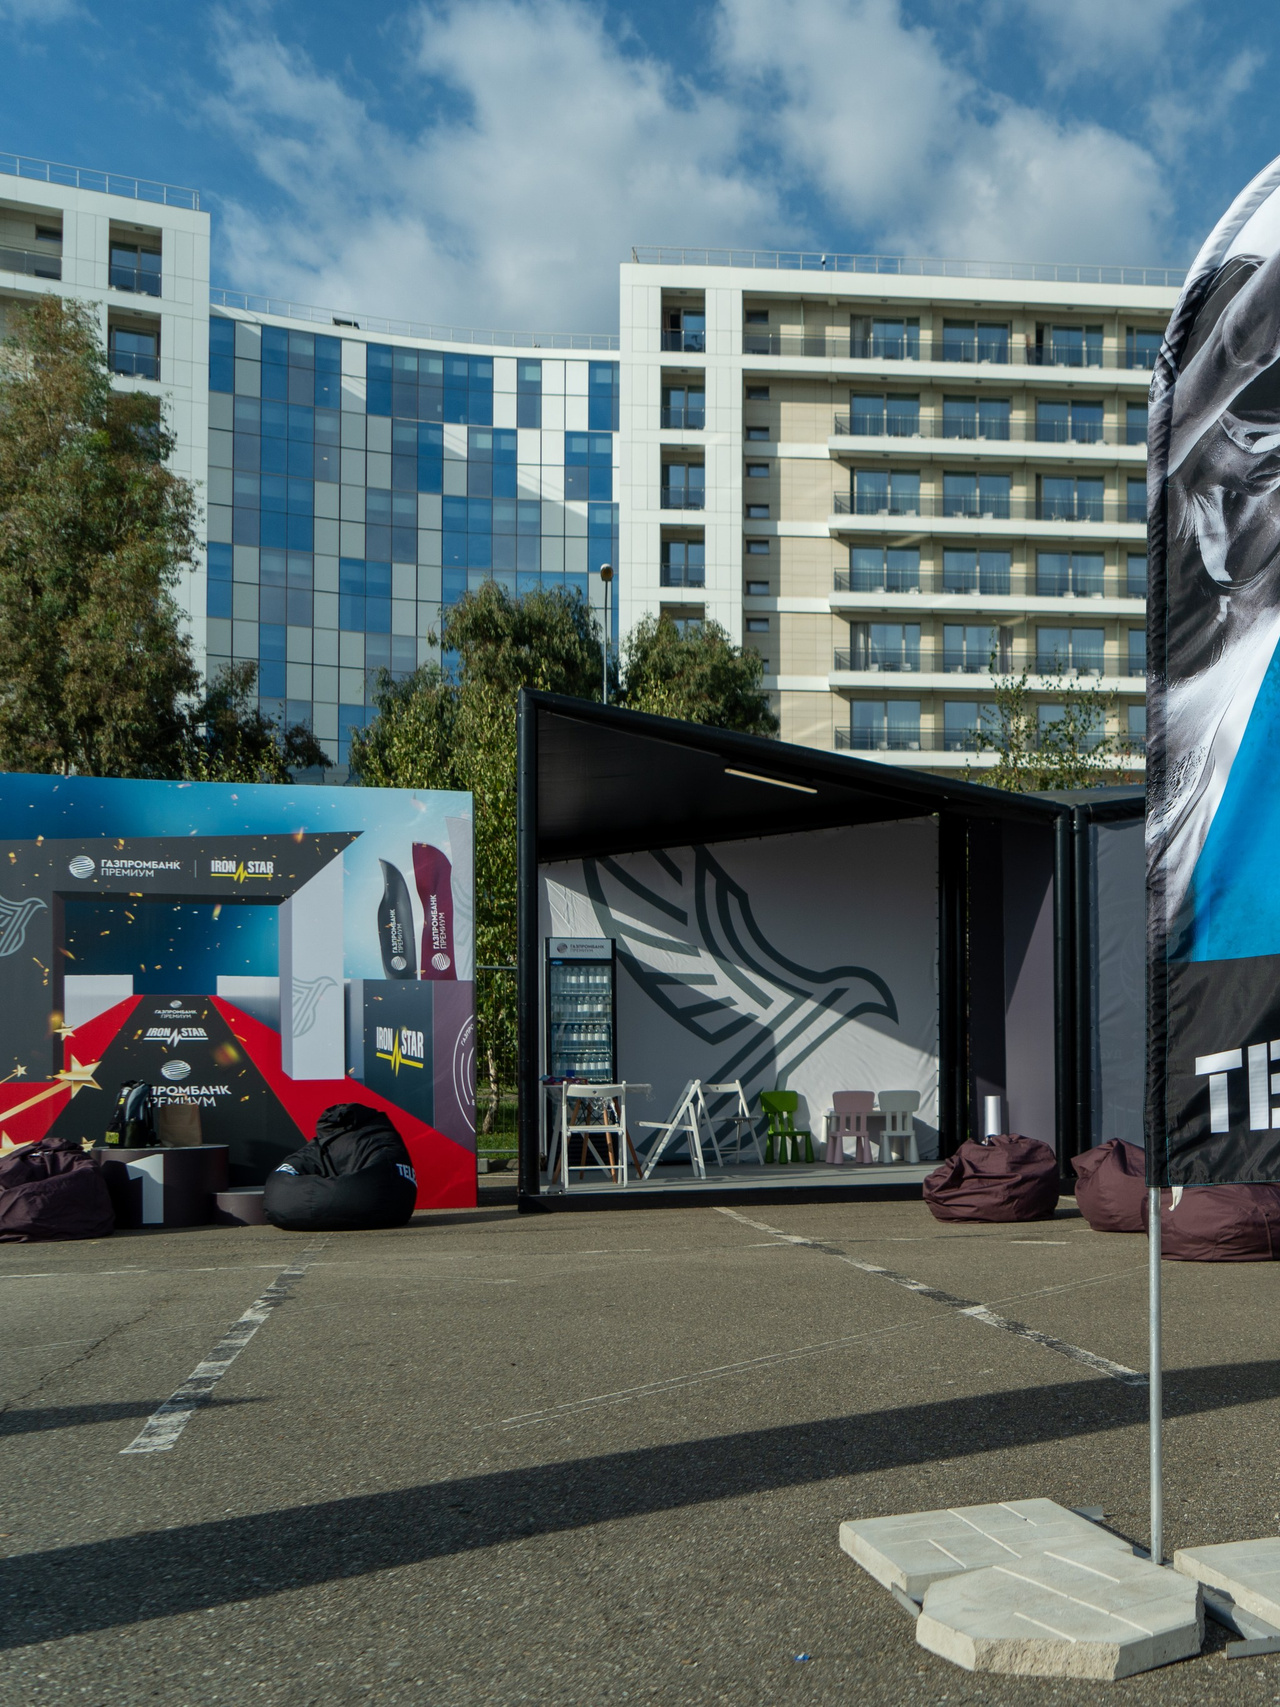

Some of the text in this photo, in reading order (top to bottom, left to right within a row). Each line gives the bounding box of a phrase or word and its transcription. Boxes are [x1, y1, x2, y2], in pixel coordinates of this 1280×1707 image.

[101, 859, 181, 870] ГАЗПРОМБАНК
[210, 860, 274, 874] IRON STAR
[101, 868, 154, 878] ПРЕМИУМ
[430, 894, 440, 949] ГАЗПРОМБАНК
[439, 912, 447, 949] ПРЕМИУМ
[146, 1027, 207, 1036] IRON STAR
[376, 1026, 424, 1058] IRON STAR
[151, 1085, 232, 1095] ПРОМБАНК
[126, 1153, 164, 1224] 1
